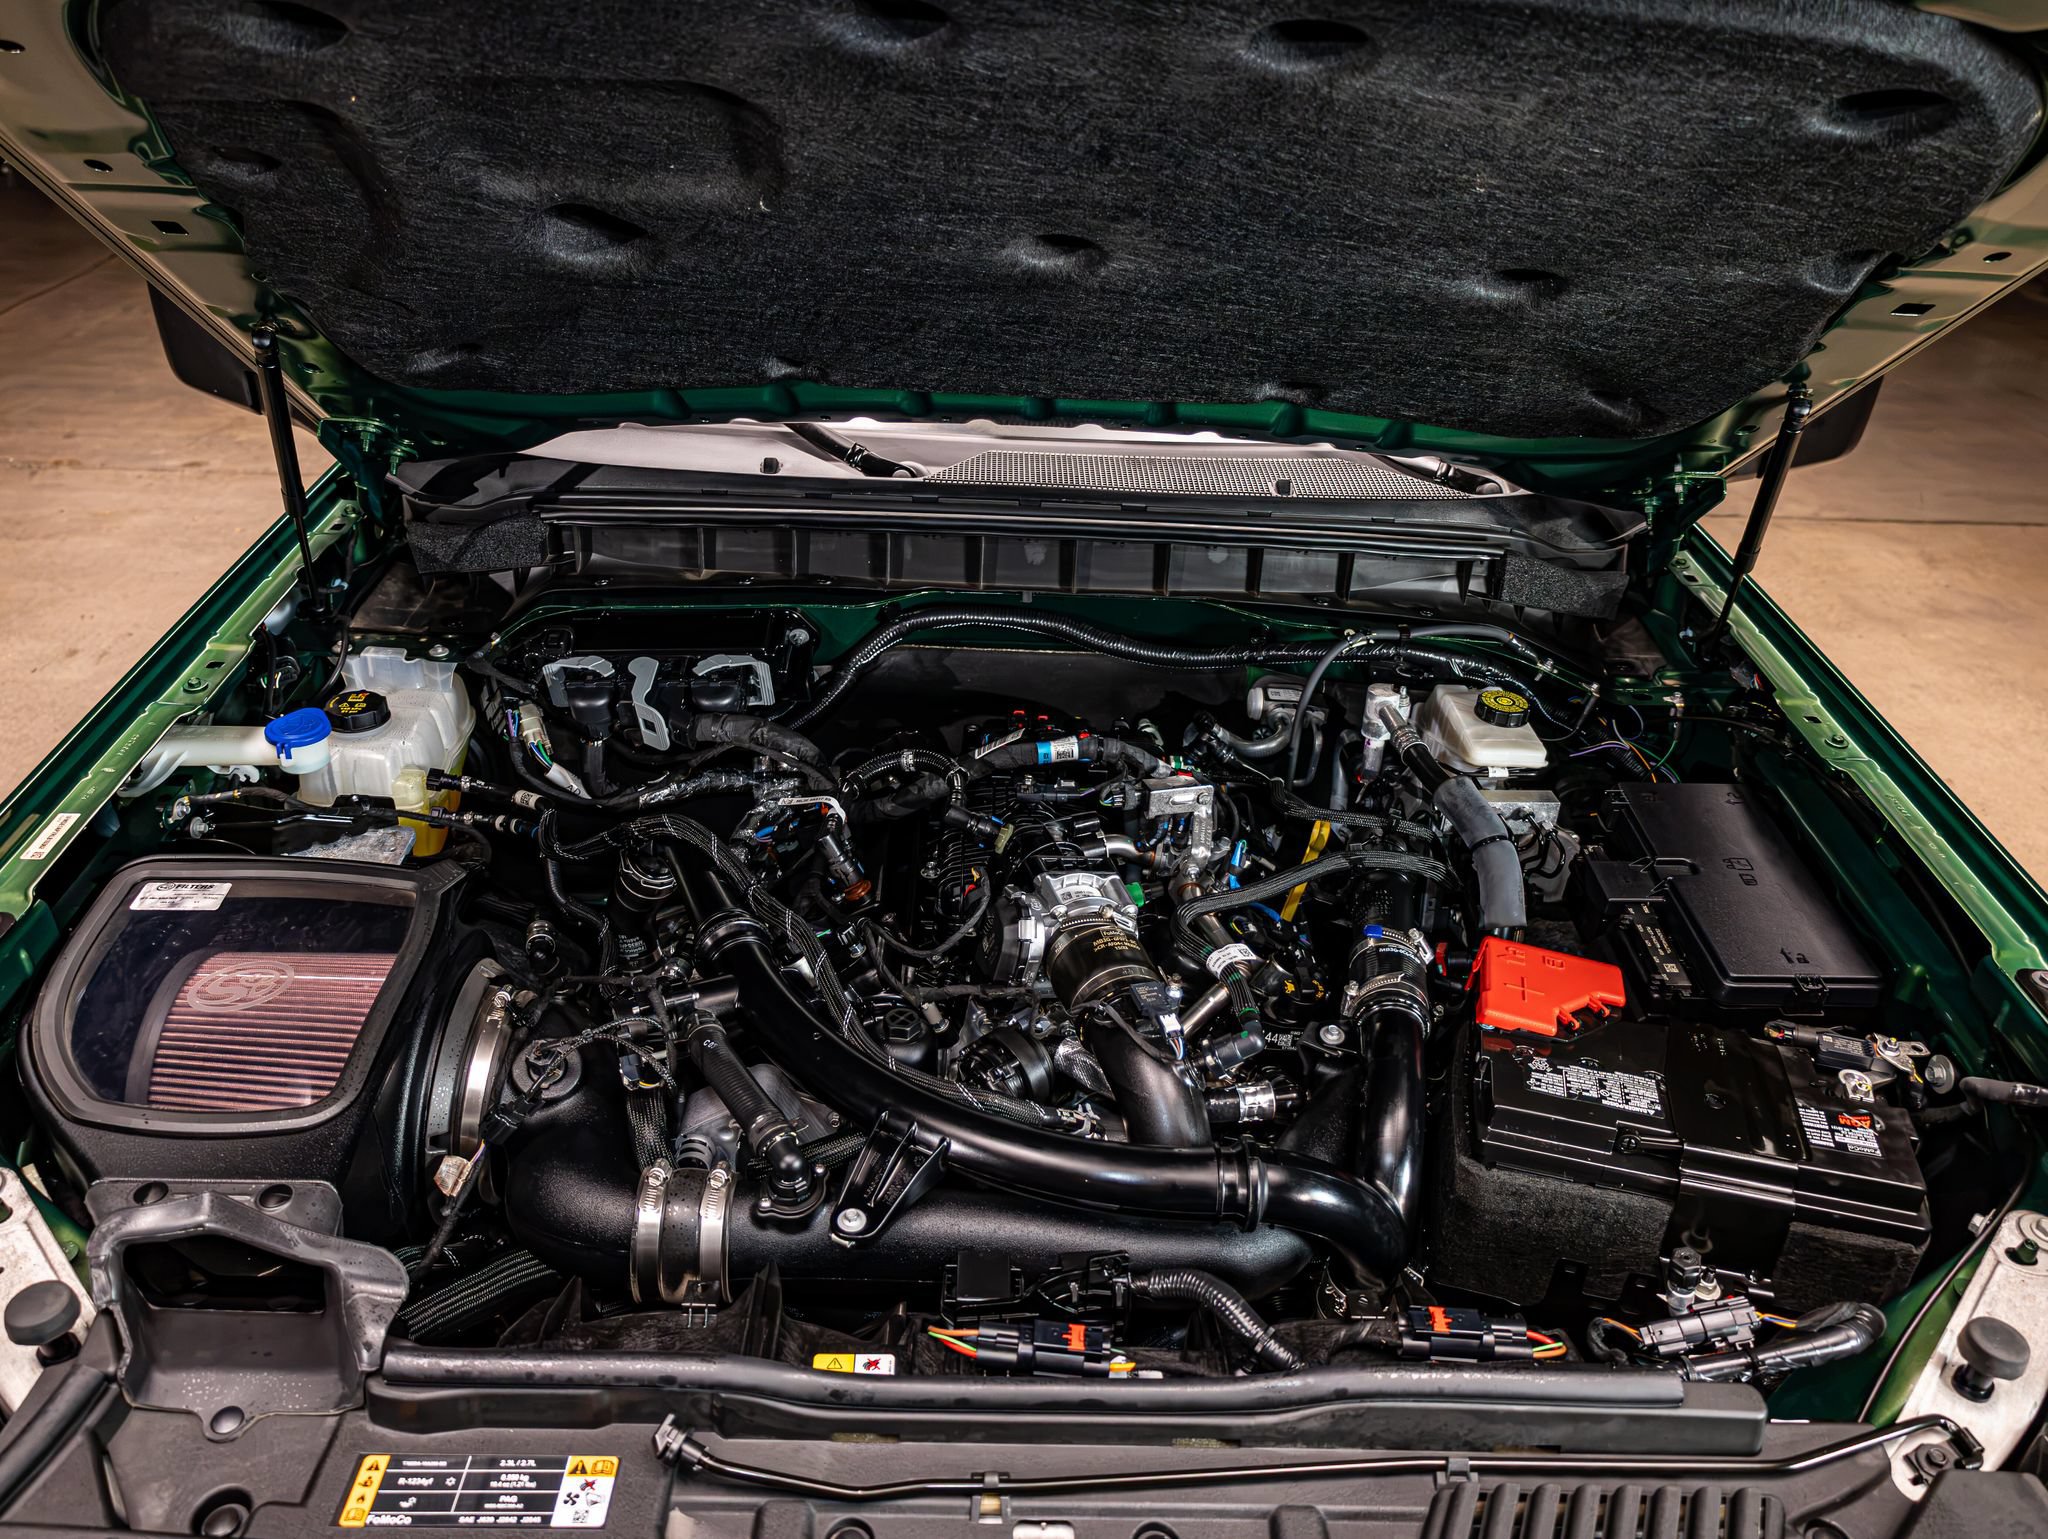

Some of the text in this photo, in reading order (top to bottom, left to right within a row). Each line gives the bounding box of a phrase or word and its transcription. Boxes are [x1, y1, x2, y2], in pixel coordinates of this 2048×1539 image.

[1837, 1117, 1871, 1129] AGM
[1848, 1144, 1880, 1154] FoMoCo
[499, 1495, 518, 1503] PAG
[366, 1514, 412, 1526] FoMoCo
[458, 1516, 476, 1524] SAE
